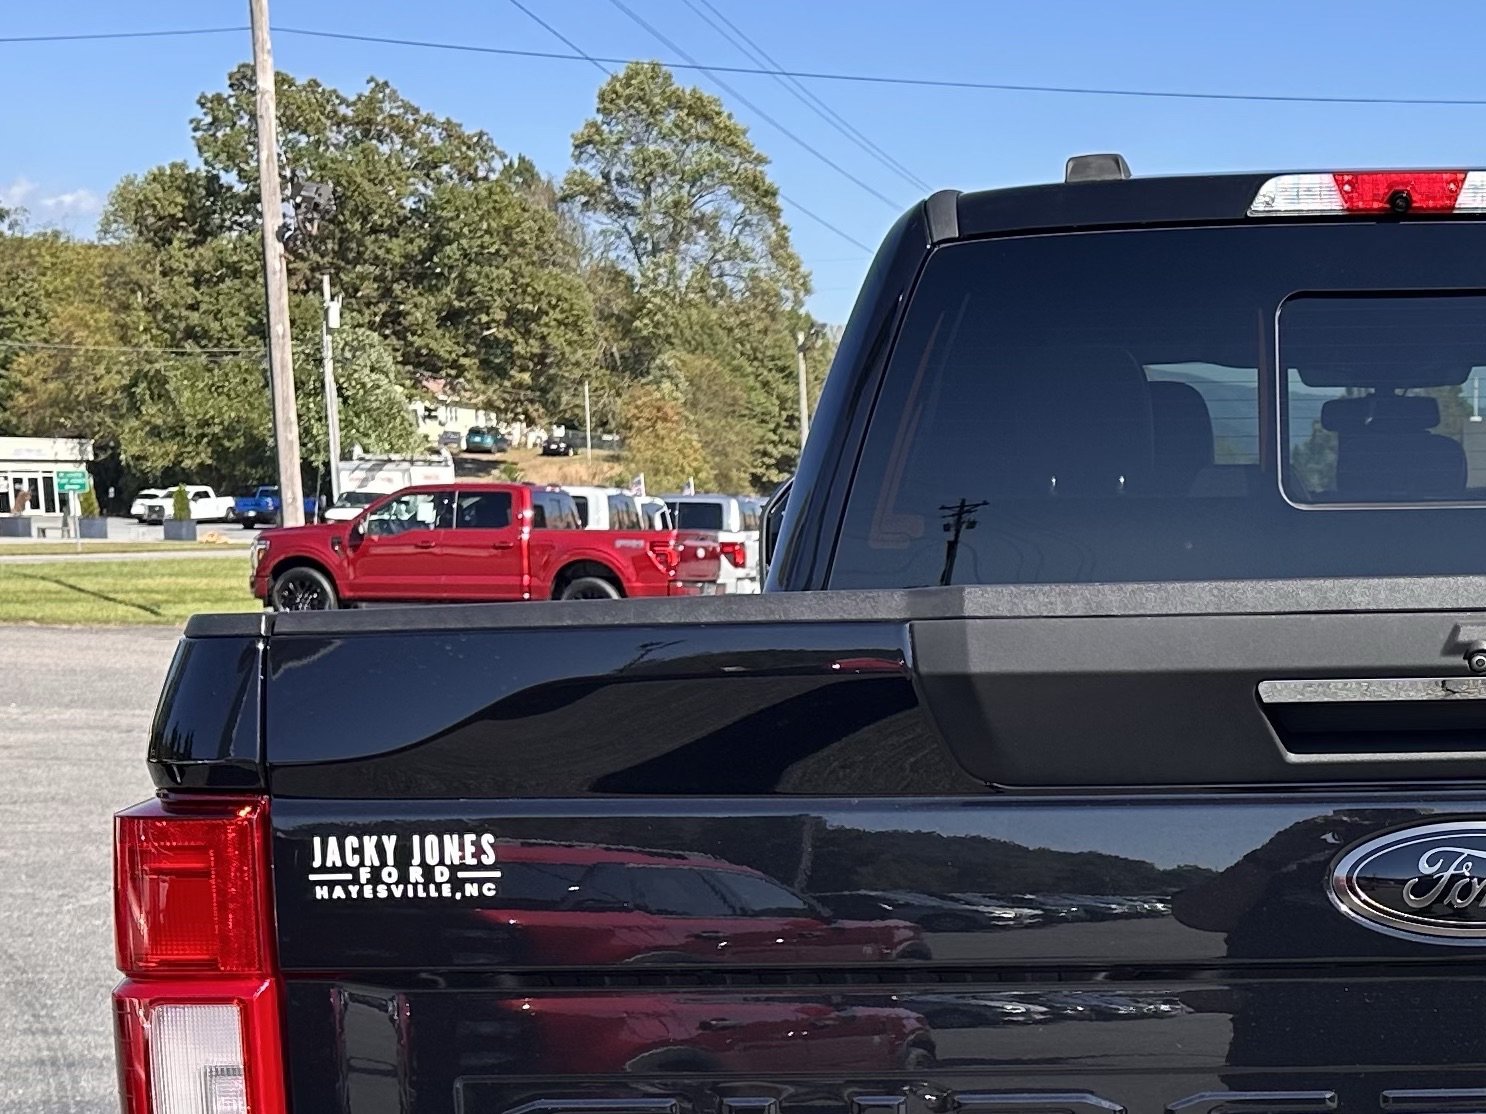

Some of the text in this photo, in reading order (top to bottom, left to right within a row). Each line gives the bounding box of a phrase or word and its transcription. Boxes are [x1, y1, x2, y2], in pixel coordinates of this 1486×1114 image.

[312, 833, 496, 868] JACKY JONES
[359, 865, 450, 884] FORD
